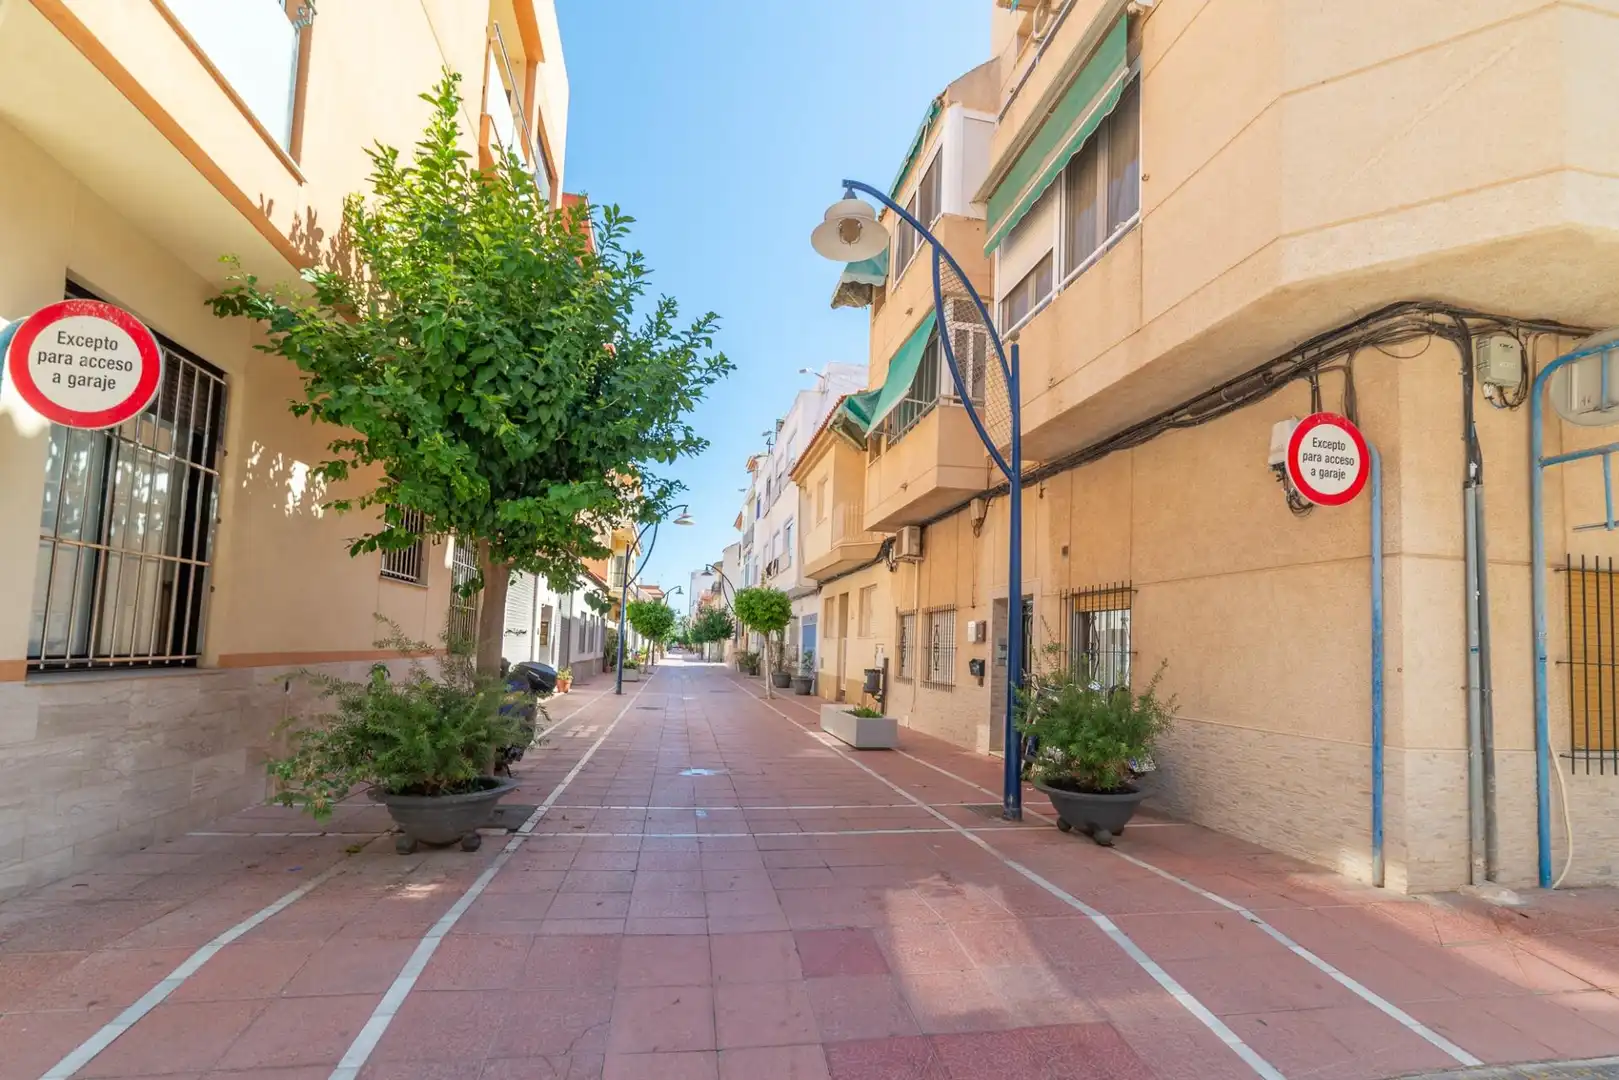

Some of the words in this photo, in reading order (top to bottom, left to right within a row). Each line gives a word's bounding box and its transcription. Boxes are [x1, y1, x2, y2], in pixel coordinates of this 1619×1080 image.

[57, 331, 118, 352] Excepto
[37, 350, 73, 365] para
[79, 356, 133, 372] acceso
[52, 372, 61, 384] a
[68, 374, 116, 392] garaje
[1312, 437, 1346, 452] Excepto
[1302, 452, 1322, 463] para
[1324, 454, 1355, 466] acceso
[1310, 468, 1316, 477] a
[1319, 468, 1346, 481] garaje
